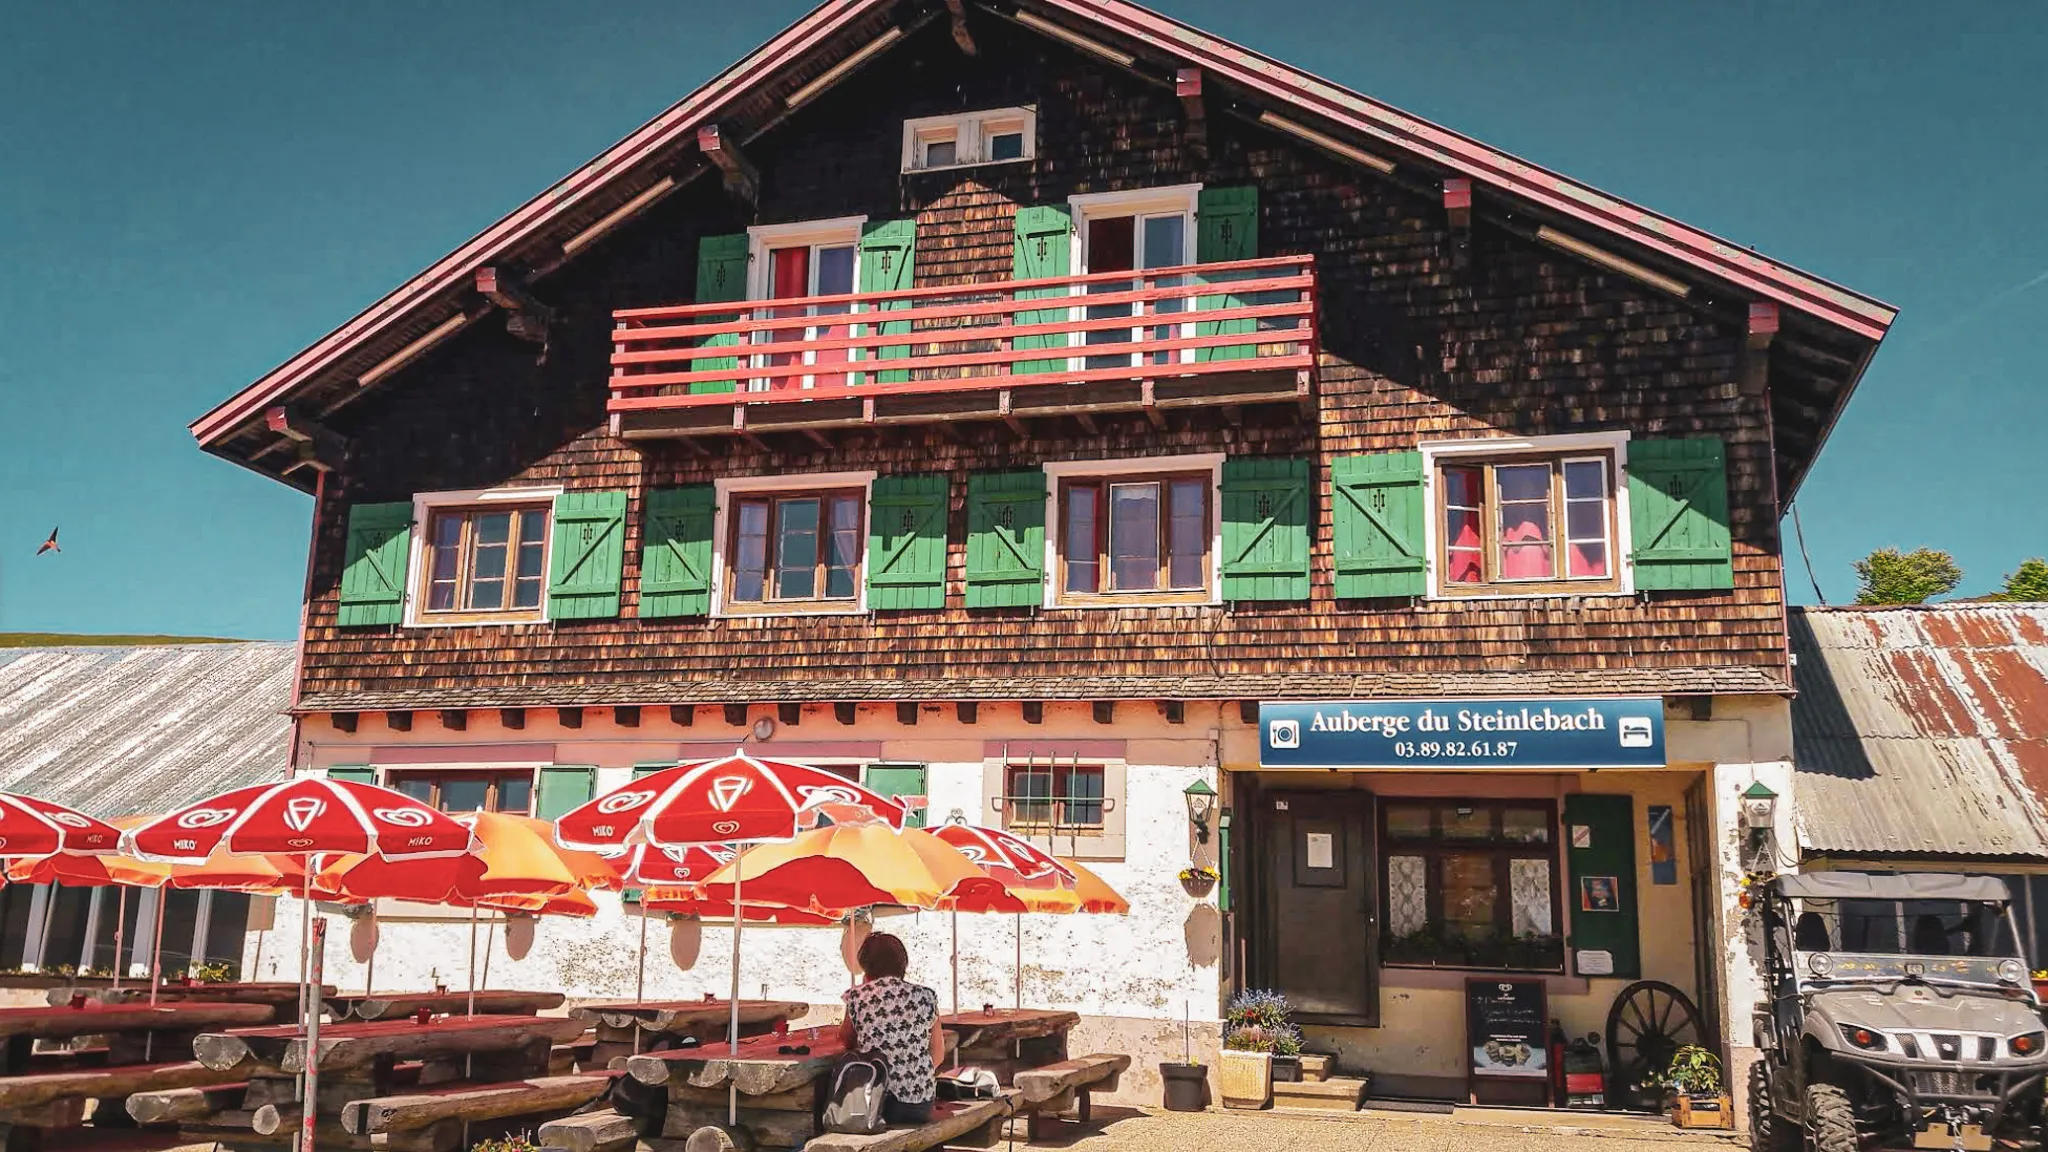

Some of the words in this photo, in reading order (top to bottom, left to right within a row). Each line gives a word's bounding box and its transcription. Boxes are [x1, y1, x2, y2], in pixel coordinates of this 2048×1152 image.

[1310, 710, 1411, 738] Auberge
[1417, 709, 1449, 732] du
[1457, 707, 1605, 731] Steinlebach
[1394, 741, 1518, 758] 03.89.82.61.87
[592, 825, 614, 837] MIKO
[173, 840, 196, 850] MIKO
[407, 836, 433, 847] MIKO
